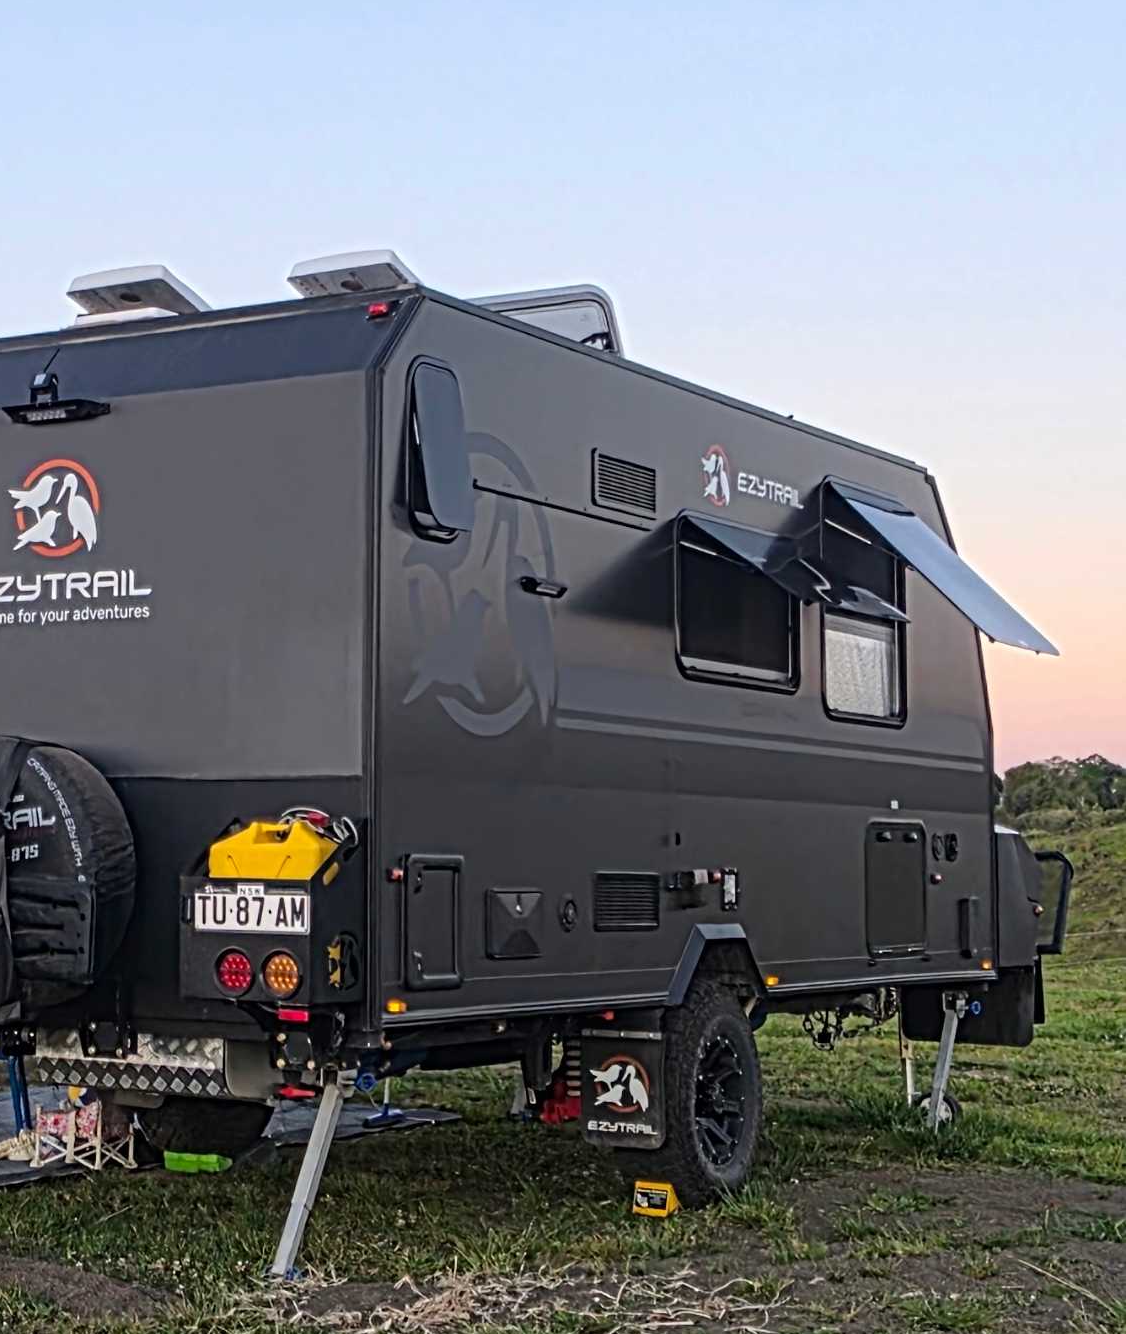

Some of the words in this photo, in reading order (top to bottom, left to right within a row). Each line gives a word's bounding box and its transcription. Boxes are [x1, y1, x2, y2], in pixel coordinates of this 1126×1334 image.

[737, 472, 805, 510] EZYTRAIL
[18, 608, 36, 623] for
[40, 609, 70, 626] your
[73, 604, 150, 622] adventures
[2, 806, 56, 830] RAIL
[239, 886, 262, 896] NSW
[587, 1120, 659, 1136] EZYTRAIL
